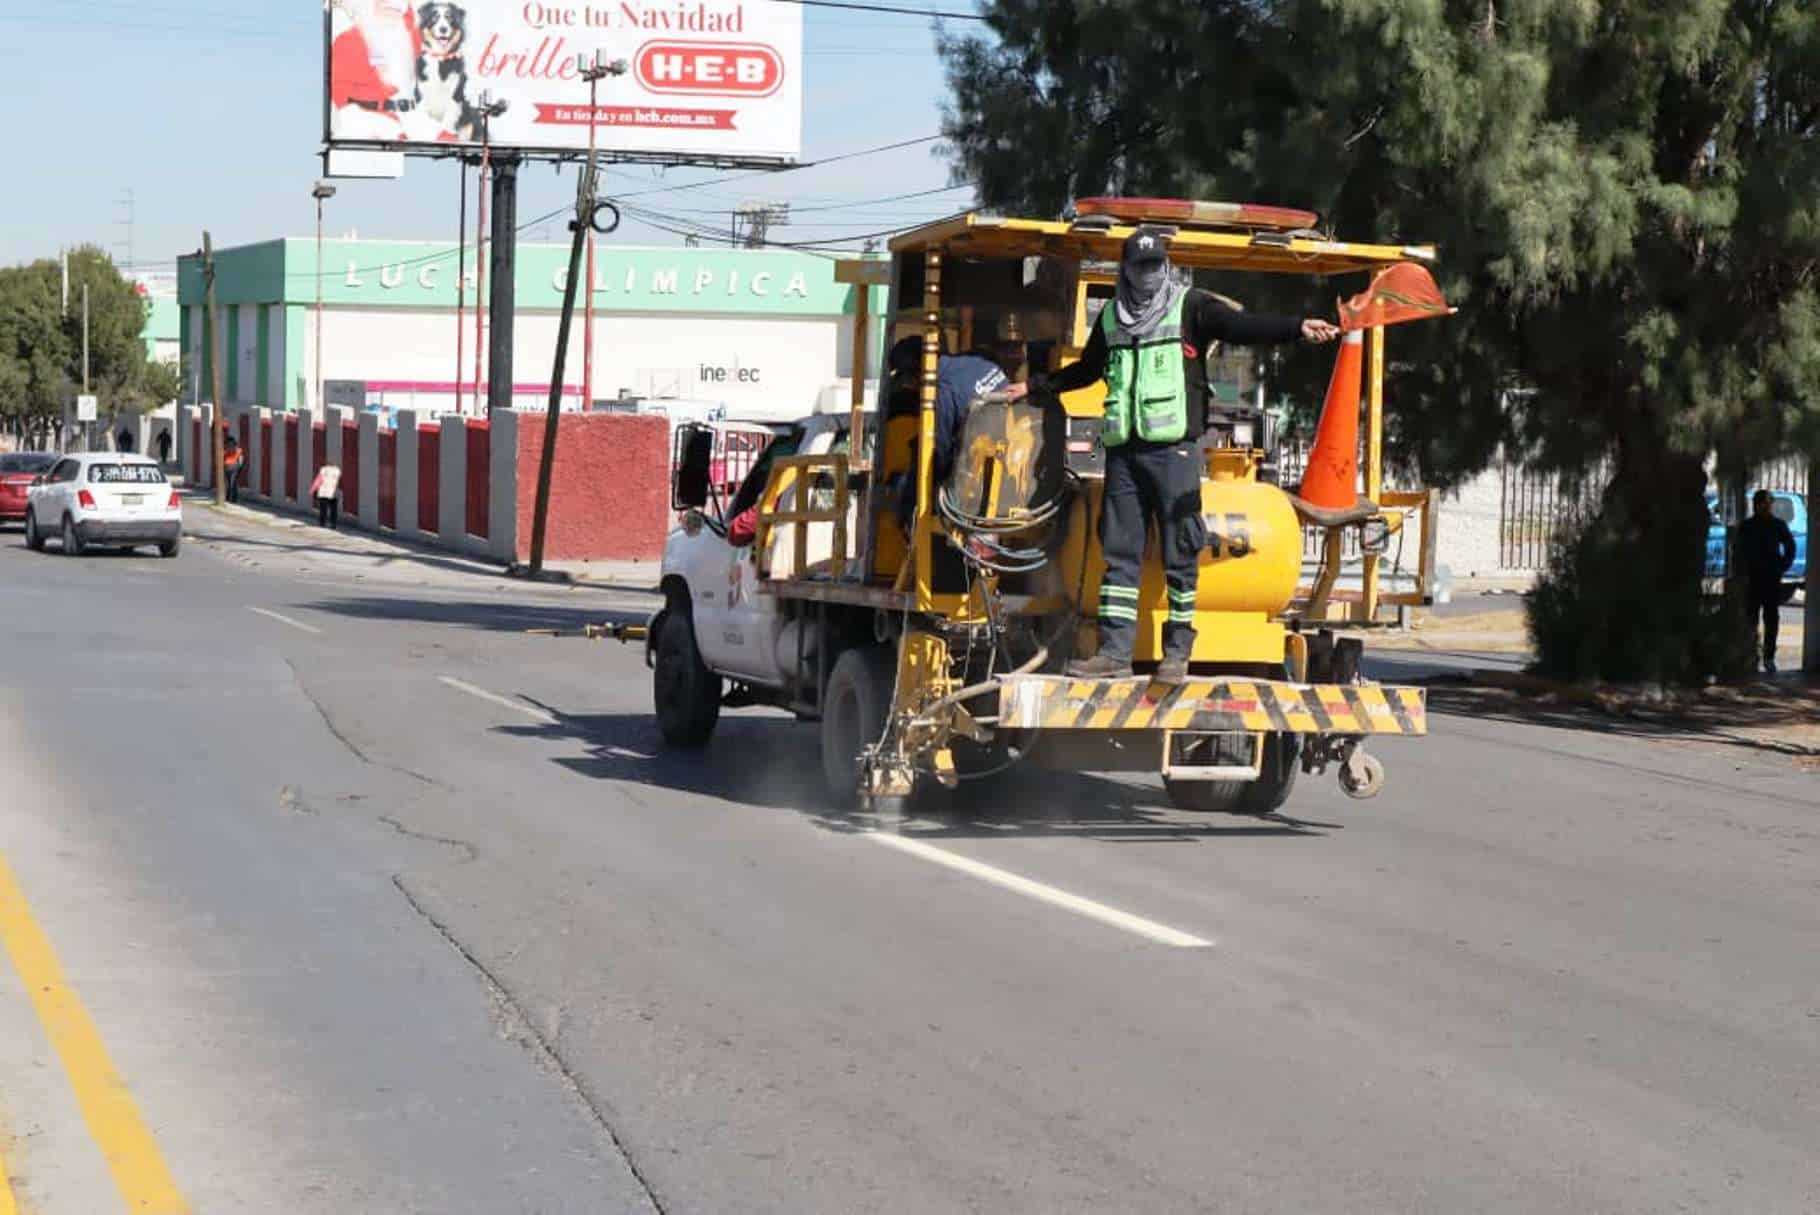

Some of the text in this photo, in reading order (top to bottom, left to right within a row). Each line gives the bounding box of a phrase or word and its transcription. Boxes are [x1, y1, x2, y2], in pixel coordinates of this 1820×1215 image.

[523, 2, 743, 33] Que tu Navidad
[478, 32, 578, 80] brille
[344, 259, 515, 290] LUCH
